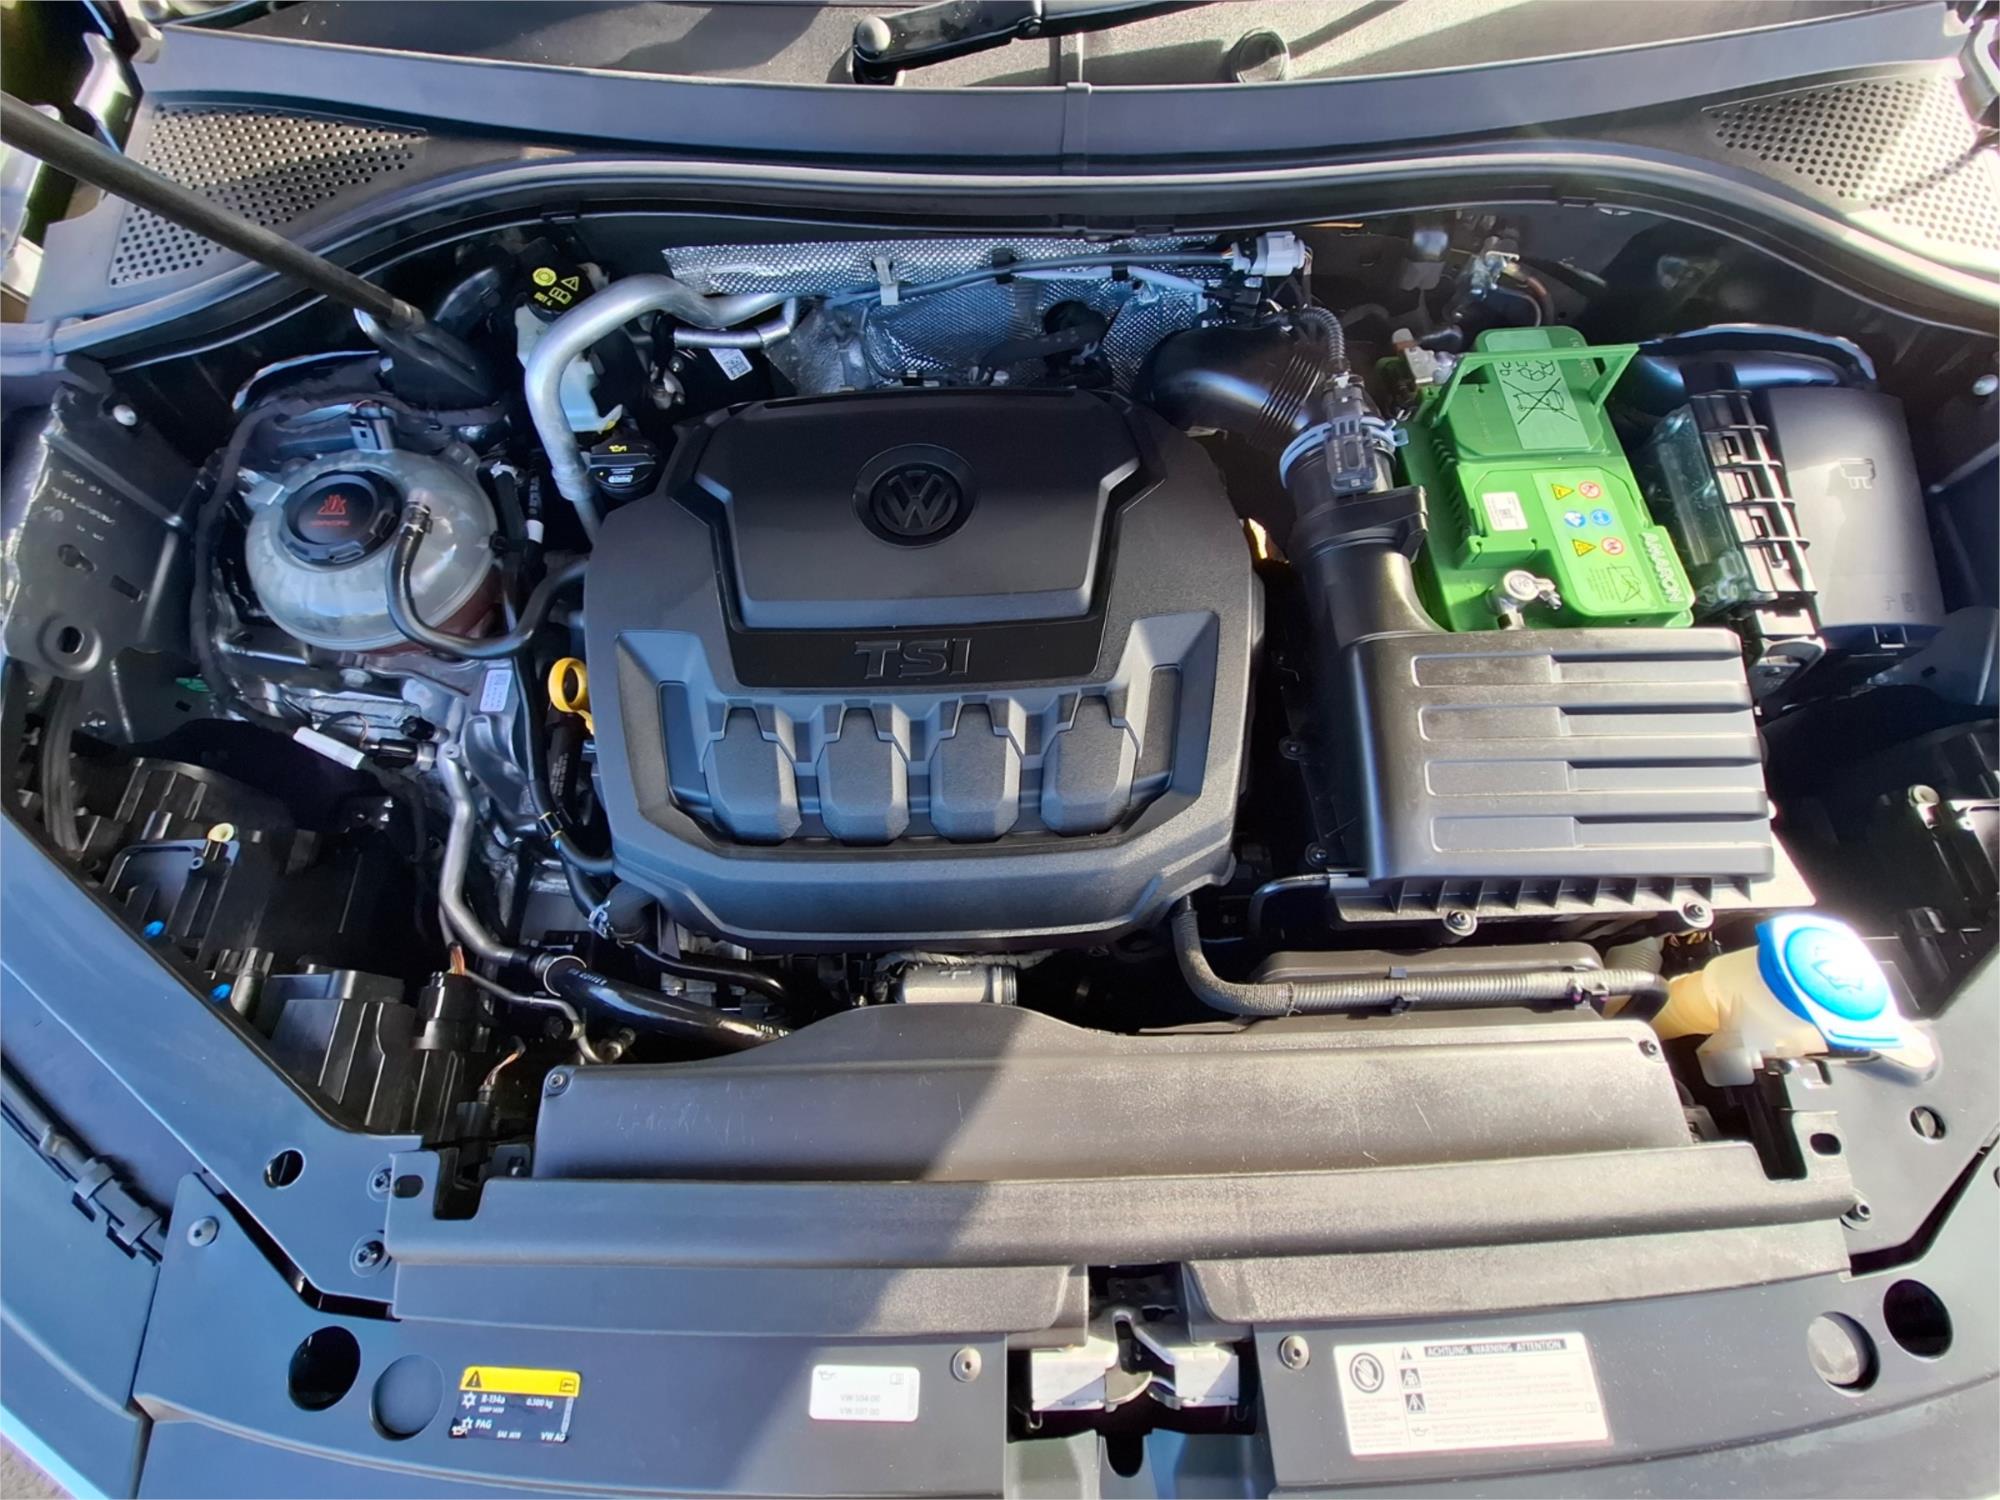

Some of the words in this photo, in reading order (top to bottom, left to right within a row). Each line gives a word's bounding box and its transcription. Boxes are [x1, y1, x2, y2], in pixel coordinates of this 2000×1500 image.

[873, 464, 957, 535] VW
[1640, 532, 1685, 602] AMARON
[854, 638, 972, 679] TSI
[1427, 1345, 1468, 1357] ACHTUNG
[1472, 1343, 1512, 1354] WARNING
[1516, 1340, 1561, 1352] ATTENTION
[475, 1420, 492, 1429] PAG
[541, 1432, 555, 1441] VW
[553, 1433, 566, 1442] AG
